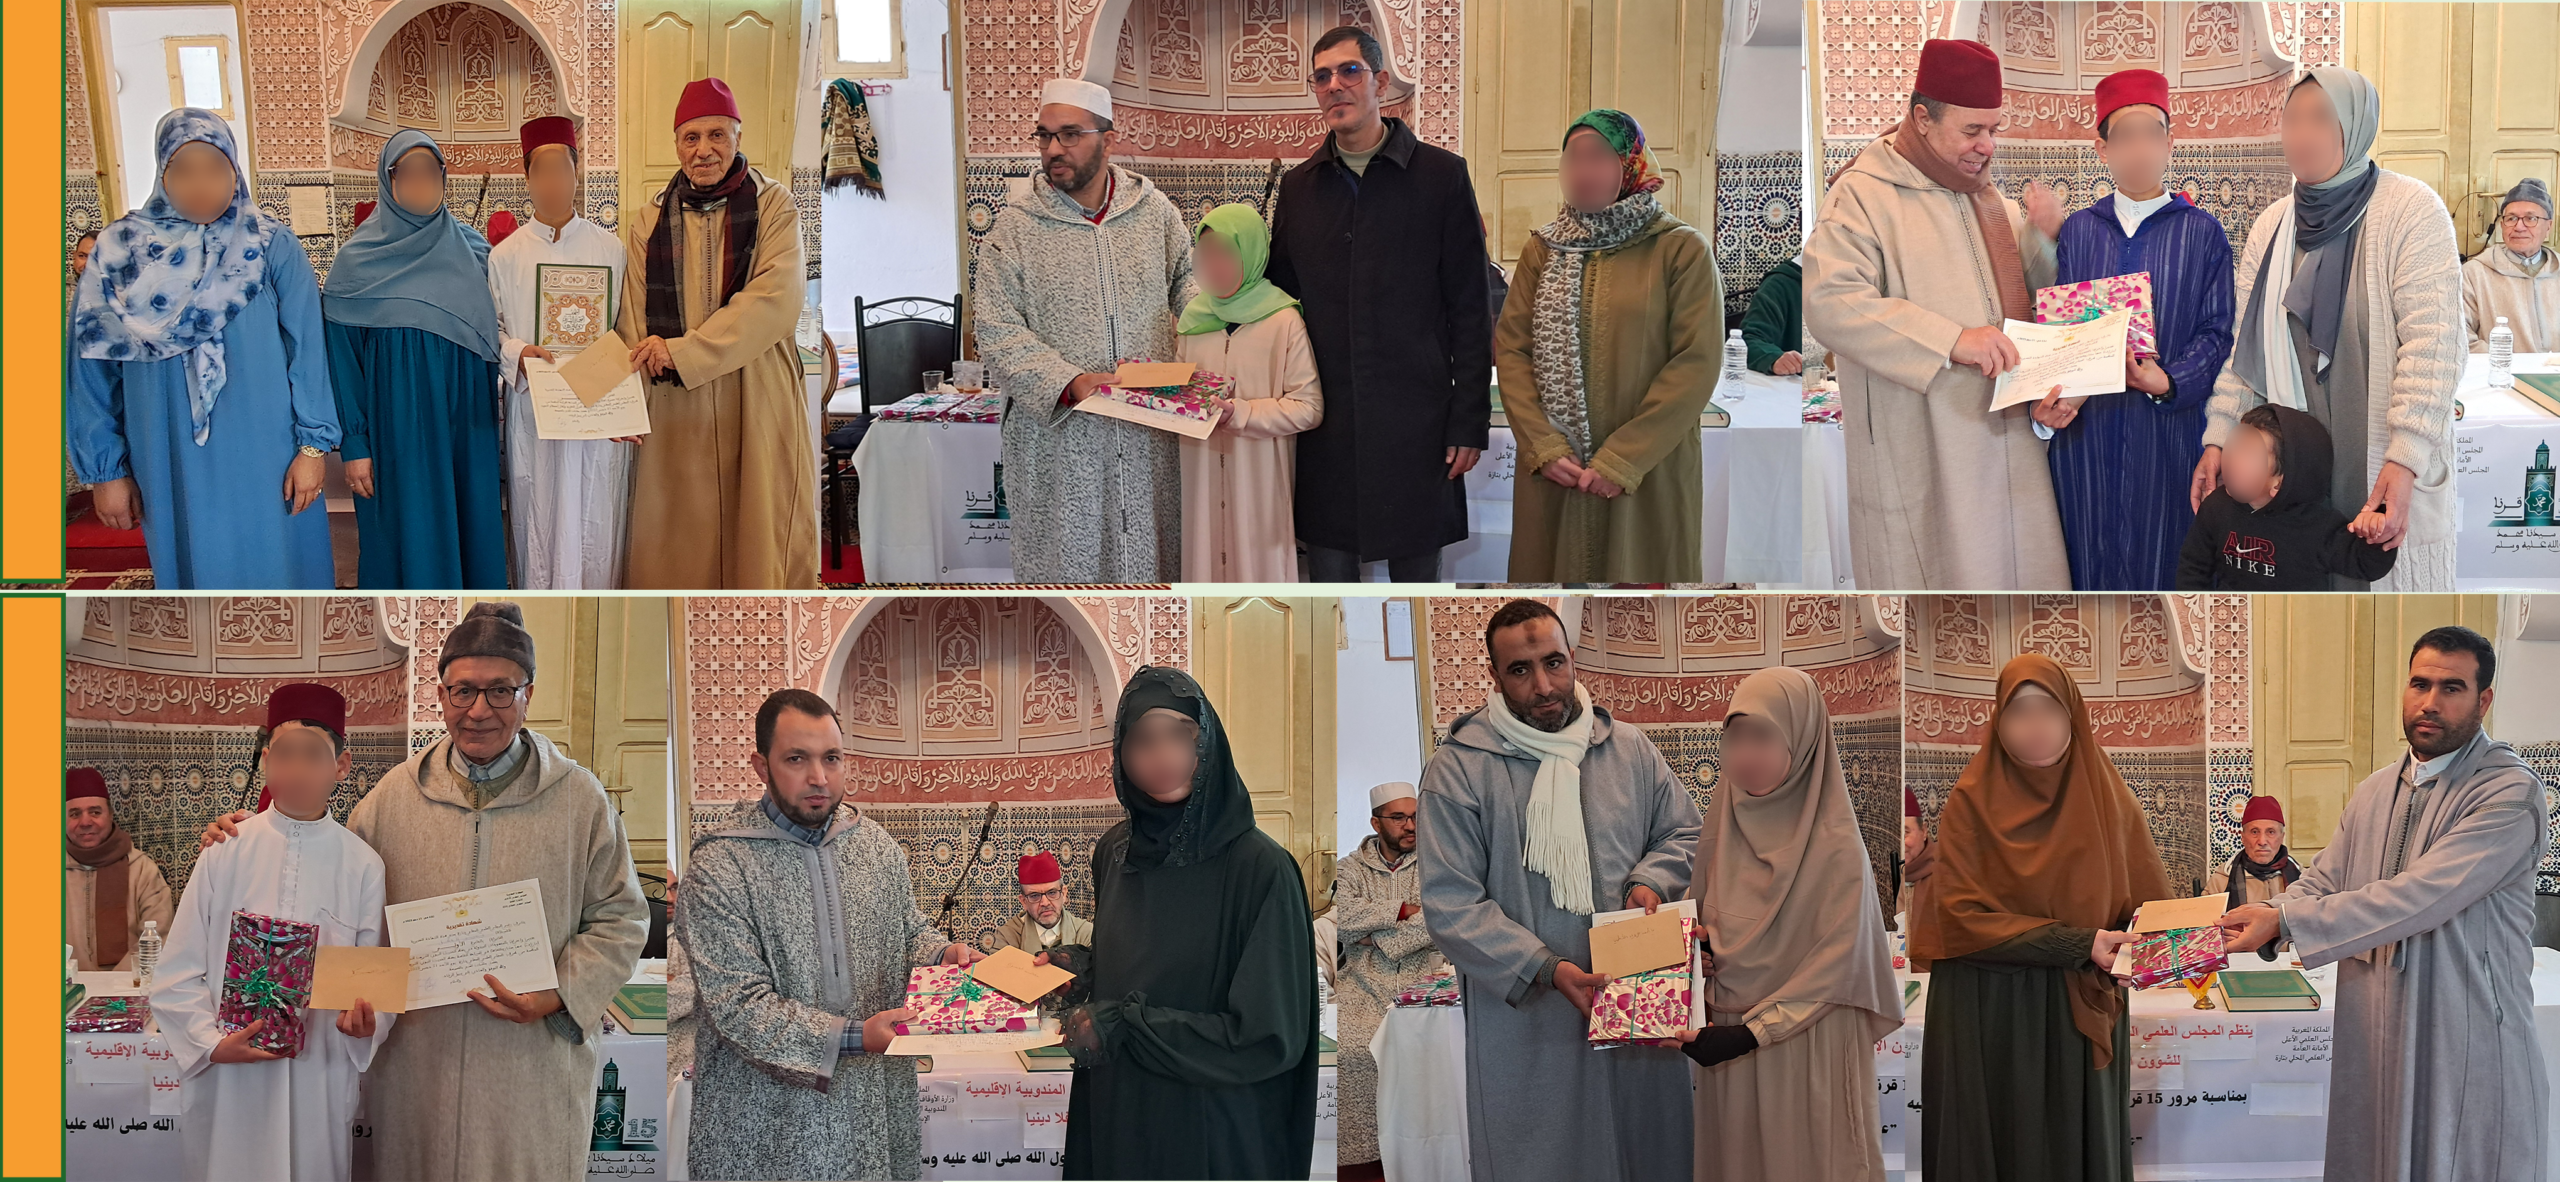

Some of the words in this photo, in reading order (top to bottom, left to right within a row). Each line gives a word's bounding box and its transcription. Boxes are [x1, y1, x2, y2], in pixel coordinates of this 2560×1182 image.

[2223, 531, 2276, 565] AIR
[2223, 553, 2276, 577] NIKE
[2142, 1025, 2177, 1042] العلمي
[2181, 1024, 2224, 1039] المجلس
[2228, 1023, 2254, 1040] ينظم
[85, 1041, 136, 1060] الإقليمية
[965, 1081, 1011, 1098] الإقليمية
[1016, 1081, 1066, 1098] المندوبية
[2147, 1093, 2163, 1104] 15
[2167, 1094, 2198, 1106] مرور
[2202, 1090, 2247, 1105] بمناسبة
[93, 1117, 114, 1130] الله
[120, 1117, 148, 1134] صلى
[153, 1118, 174, 1131] الله
[1026, 1112, 1051, 1126] دينيا
[627, 1118, 658, 1138] 15
[942, 1152, 967, 1167] عليه
[971, 1151, 991, 1163] الله
[995, 1151, 1021, 1166] صلى
[1026, 1151, 1046, 1163] الله
